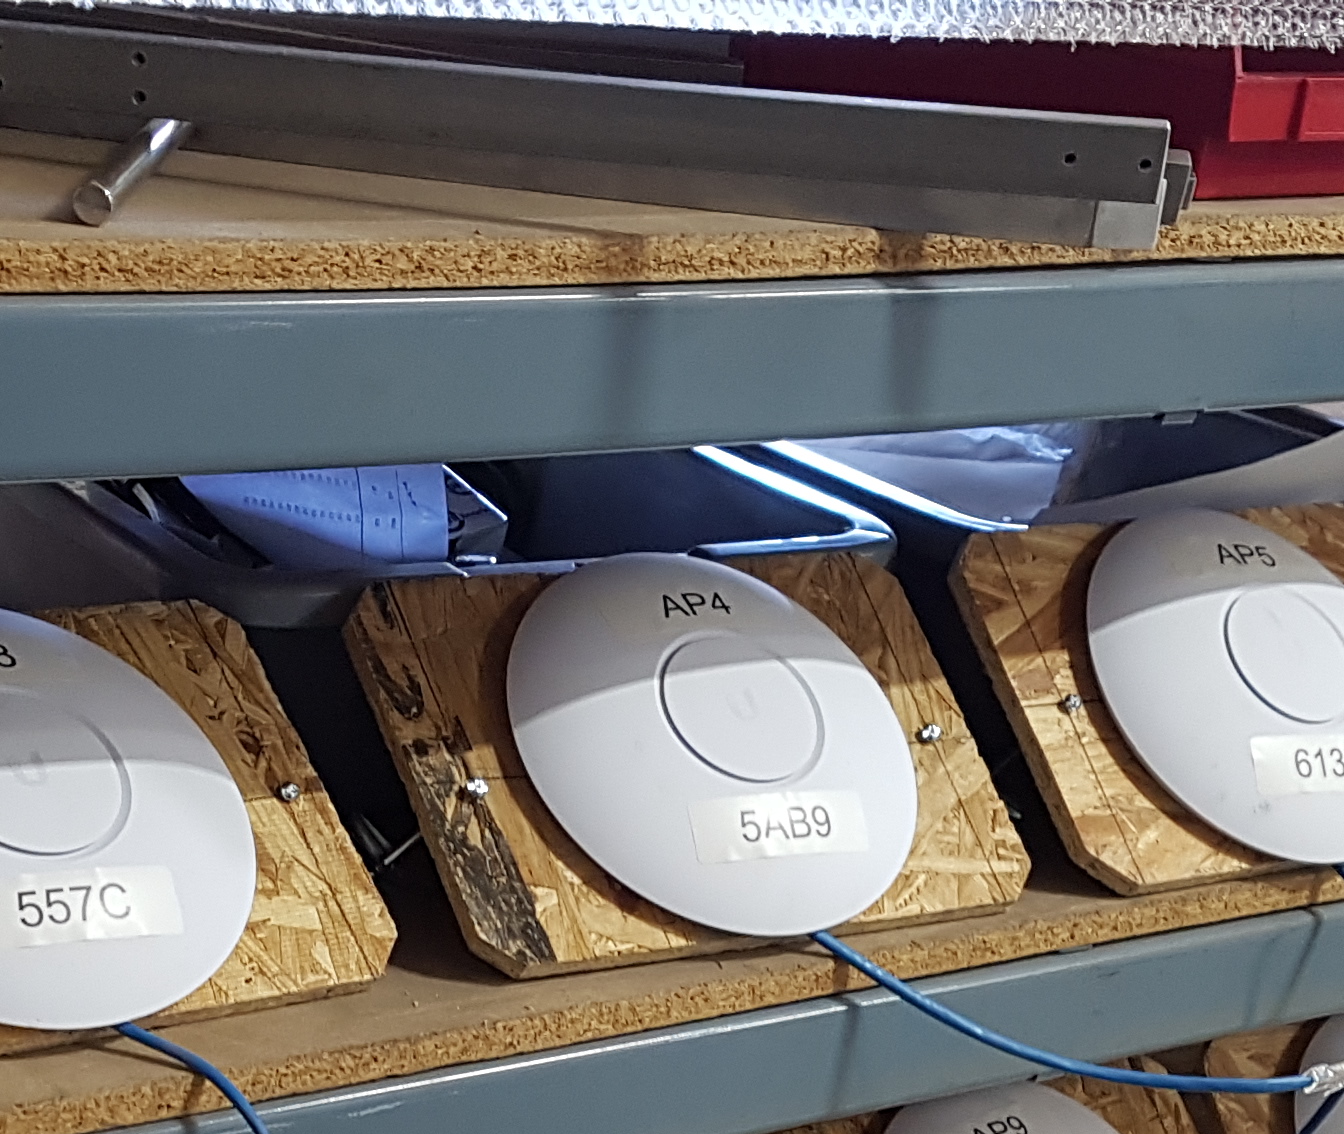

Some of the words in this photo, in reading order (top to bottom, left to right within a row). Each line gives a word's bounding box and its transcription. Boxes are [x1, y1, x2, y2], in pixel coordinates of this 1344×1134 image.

[1217, 543, 1276, 568] AP5
[662, 591, 731, 619] AP4
[740, 805, 832, 843] 5AB9
[17, 882, 130, 928] 557C
